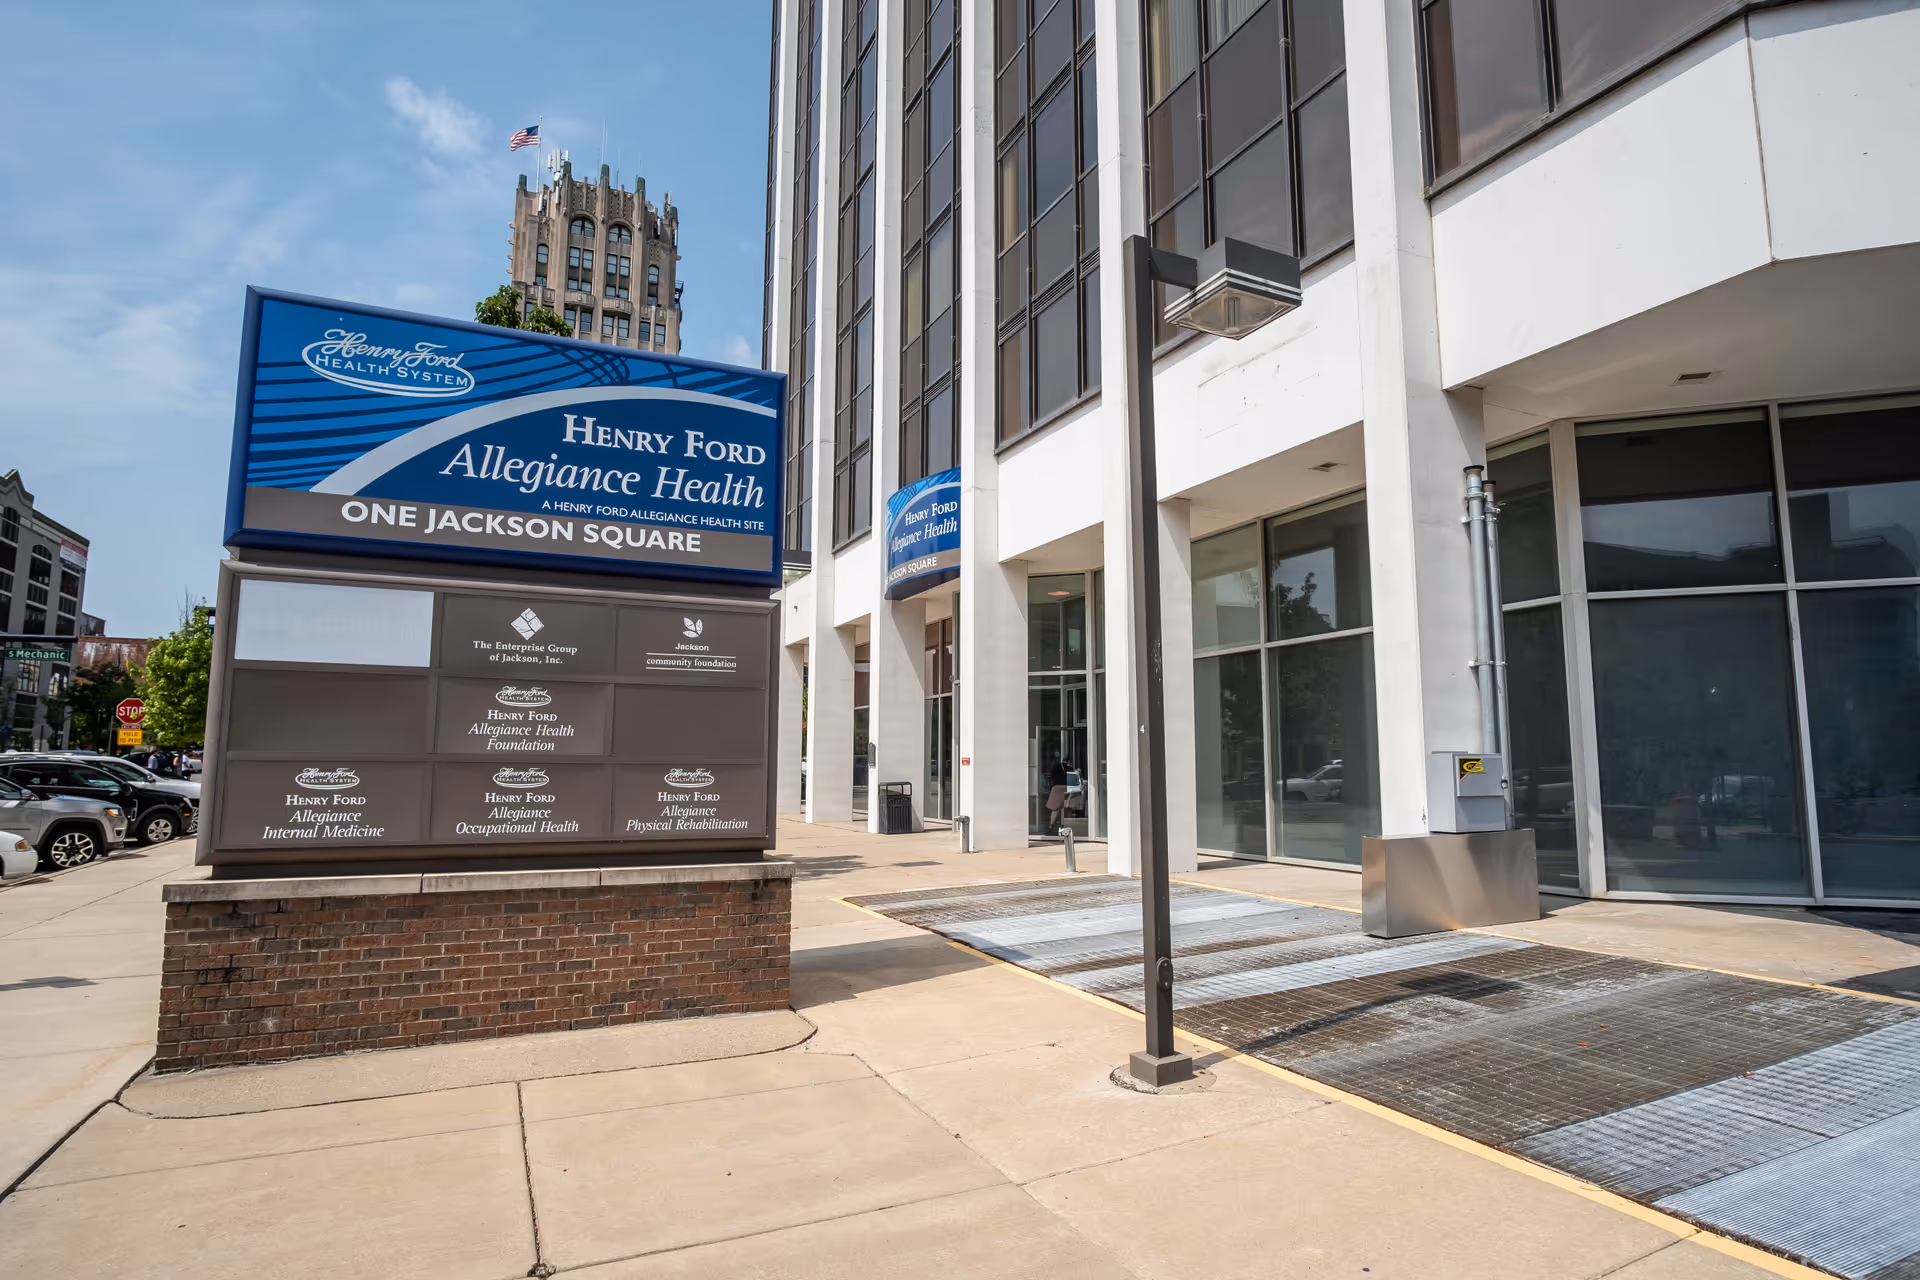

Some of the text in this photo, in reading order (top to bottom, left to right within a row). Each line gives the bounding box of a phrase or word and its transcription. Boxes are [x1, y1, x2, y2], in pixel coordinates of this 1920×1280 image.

[315, 354, 468, 387] HEALTH SYSTEM
[563, 413, 766, 465] HENRY FORD
[439, 443, 765, 508] Allegiance Health
[542, 500, 765, 531] A HENRY FORD ALLEGIANCE HEALTH SITE
[905, 508, 930, 526] HENRY
[931, 501, 958, 517] FORD
[341, 501, 701, 552] ONE JACKSON SQUARE
[924, 517, 958, 540] Health
[908, 556, 937, 575] SQUARE
[16, 649, 65, 660] Mechanic
[473, 640, 578, 656] The Enterprise Group
[675, 642, 709, 652] Jackson
[489, 653, 564, 665] of Jackson, Inc.
[646, 657, 737, 668] community foundation
[487, 709, 558, 722] HENRY FORD
[467, 722, 575, 737] Allegiance Health
[486, 738, 555, 751] Foundation
[285, 794, 367, 806] HENRY FORD
[485, 792, 555, 803] HENRY FORD
[657, 791, 720, 802] HENRY FORD
[289, 809, 362, 825] Allegiance
[488, 806, 552, 821] Allegiance
[661, 805, 717, 819] Allegiance
[262, 824, 385, 839] Internal Medicine
[456, 820, 579, 836] Occupational Health
[626, 818, 748, 834] Physical Rehabilitation
